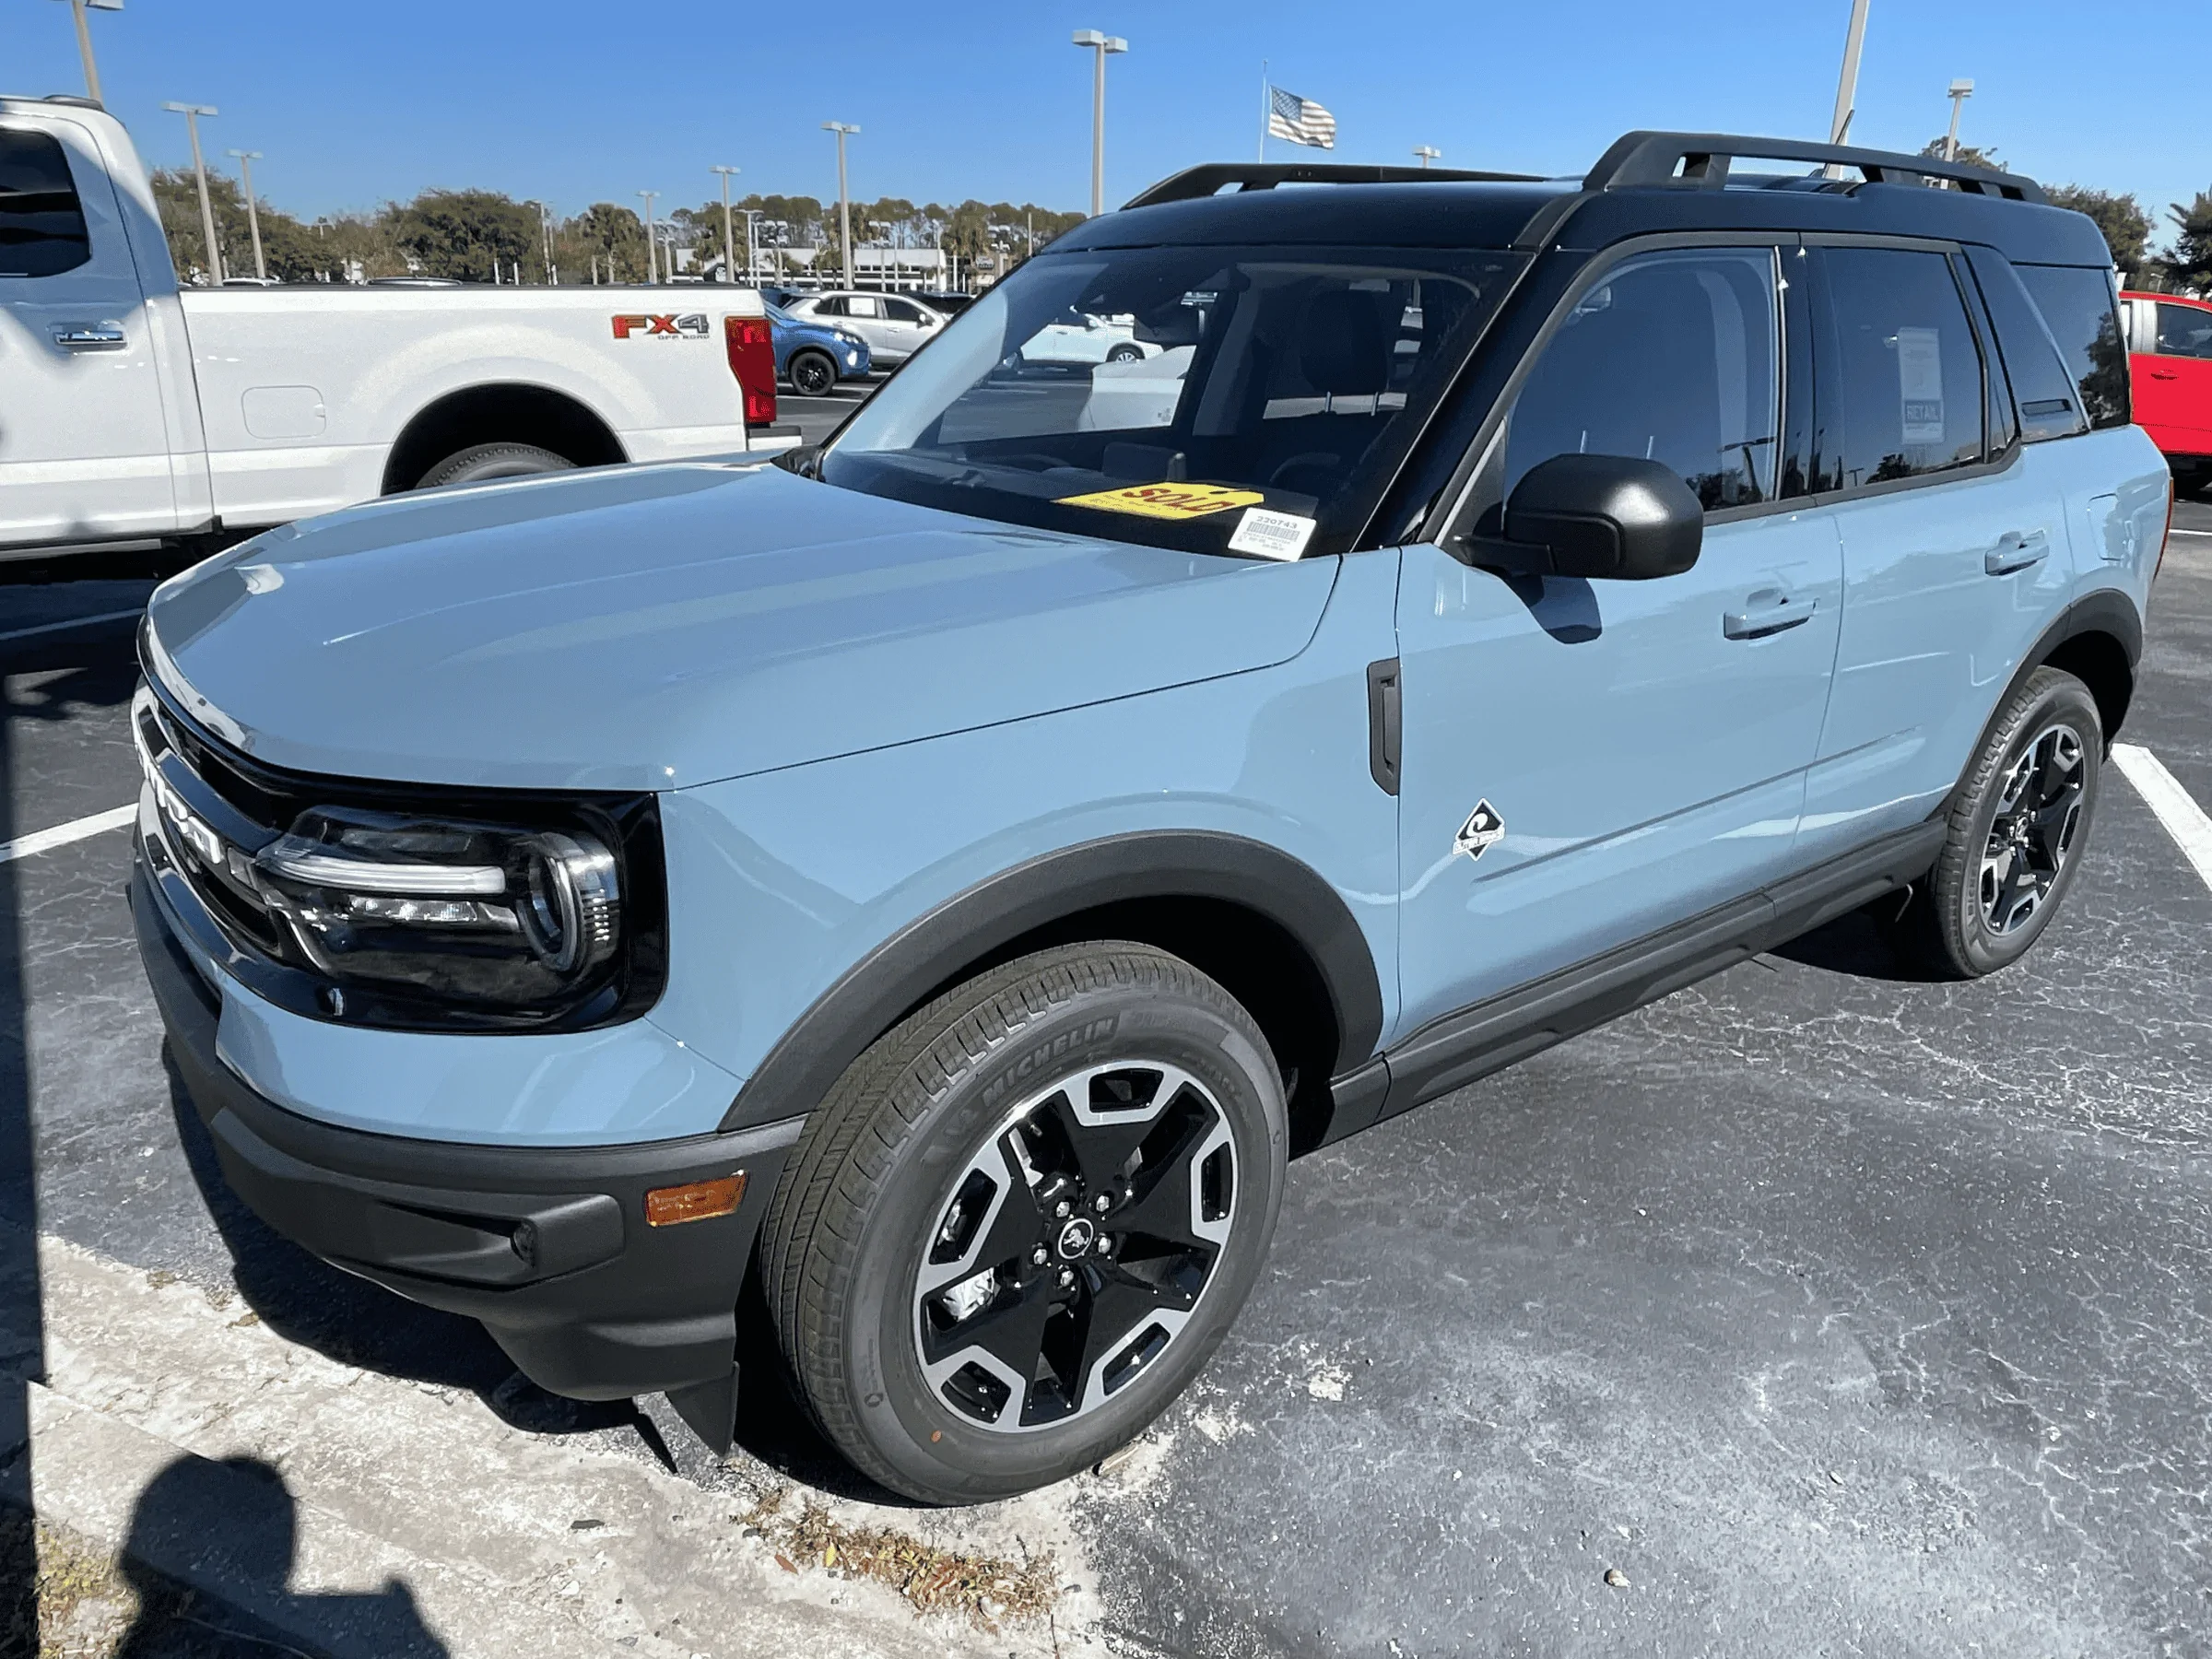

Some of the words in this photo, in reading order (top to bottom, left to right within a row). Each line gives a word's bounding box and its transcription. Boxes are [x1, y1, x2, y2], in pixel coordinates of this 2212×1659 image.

[611, 313, 710, 339] FX4
[1121, 488, 1237, 512] SOLD
[982, 1018, 1114, 1107] MICHELIN
